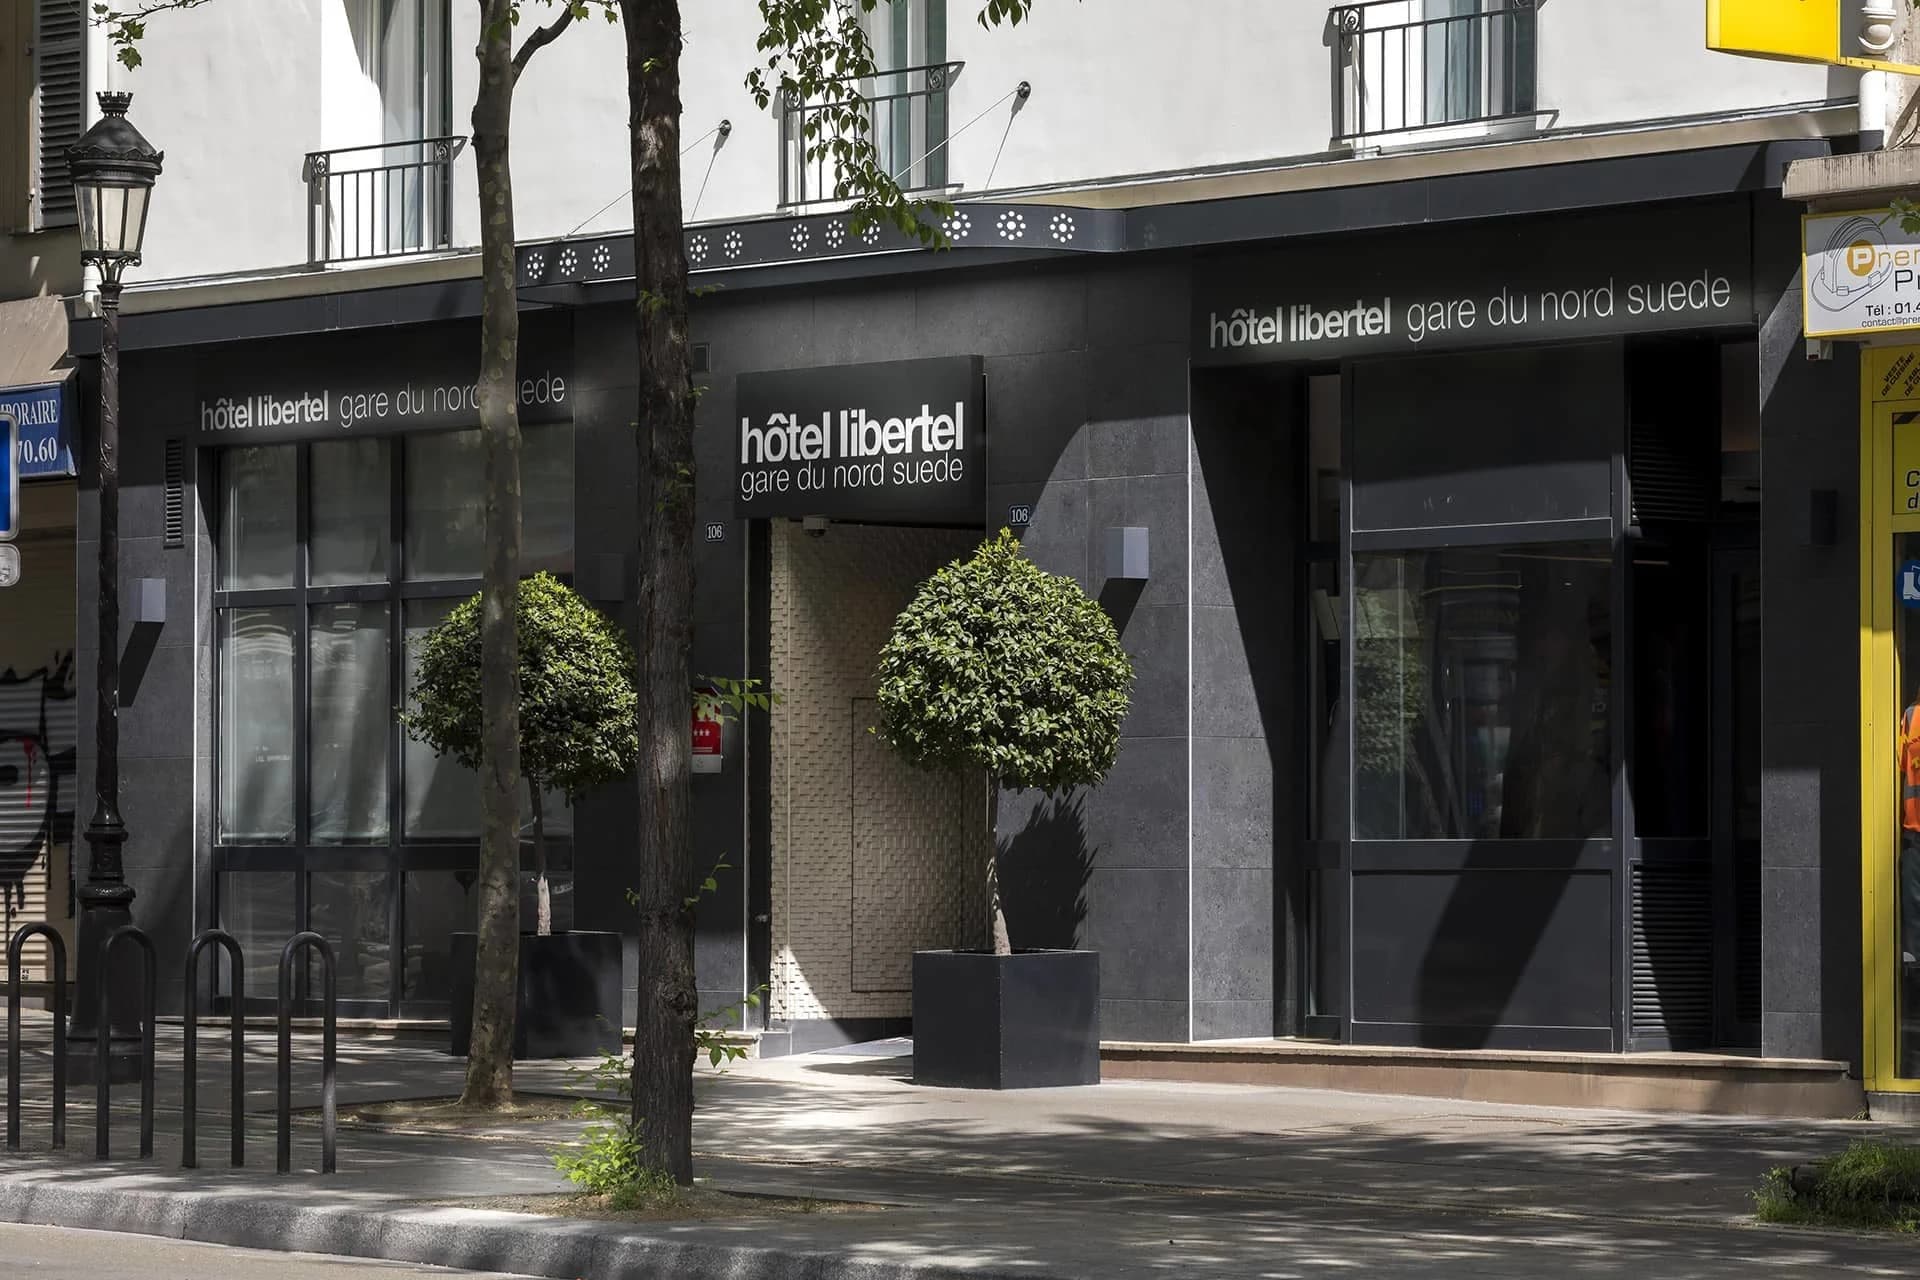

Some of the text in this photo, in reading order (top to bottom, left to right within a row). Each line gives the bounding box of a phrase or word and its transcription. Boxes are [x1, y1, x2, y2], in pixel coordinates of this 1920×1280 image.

[1853, 247, 1920, 270] Pre
[1895, 270, 1920, 292] P
[1210, 269, 1730, 348] hôtel libertel gare du nord suede
[1865, 304, 1884, 317] Tél
[201, 397, 252, 431] hôtel
[258, 390, 328, 426] libertel
[340, 392, 389, 428] gare
[396, 382, 425, 415] du
[517, 370, 565, 405] ede
[741, 402, 964, 464] hôtel libertel
[741, 452, 963, 501] gare du nord suede
[1012, 508, 1028, 522] 106
[708, 525, 722, 538] 106
